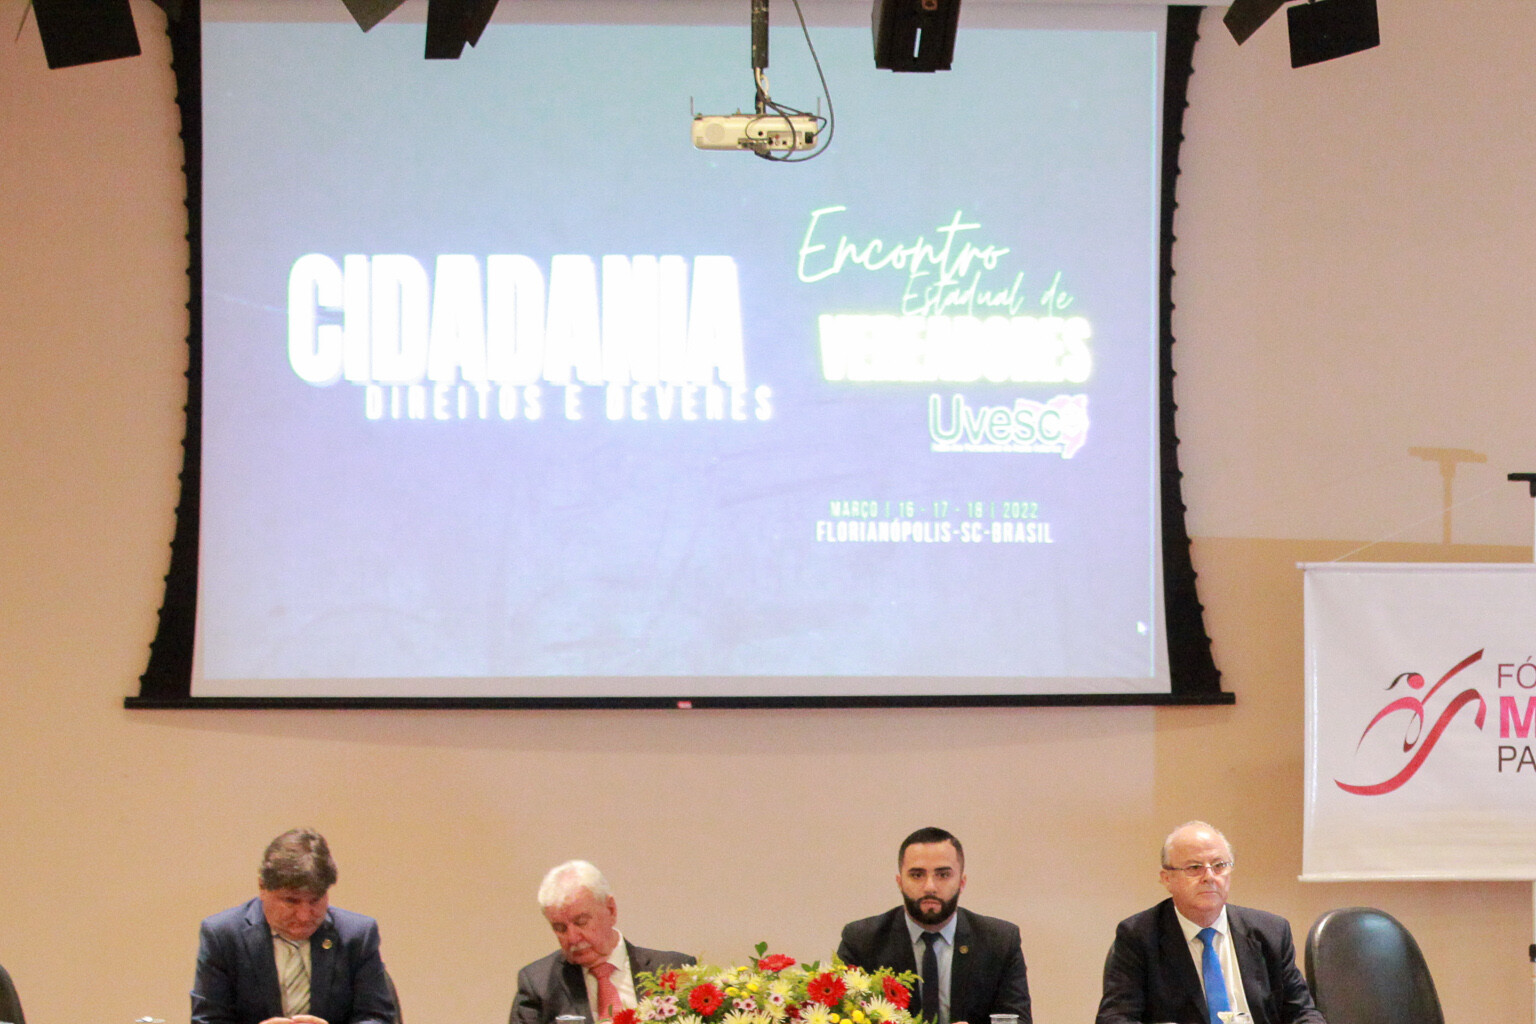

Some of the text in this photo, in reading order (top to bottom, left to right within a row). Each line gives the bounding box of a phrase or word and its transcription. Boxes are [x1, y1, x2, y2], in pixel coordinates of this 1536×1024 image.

[797, 205, 1011, 284] Encontro
[1040, 270, 1074, 317] de
[288, 254, 745, 385] CIDADANIA
[365, 384, 774, 421] DIREITOS E DEVERES
[929, 393, 1062, 443] Uvesc
[829, 501, 878, 520] MARÇO
[899, 502, 915, 518] 16
[933, 502, 949, 518] 17
[1001, 502, 1039, 519] 2022
